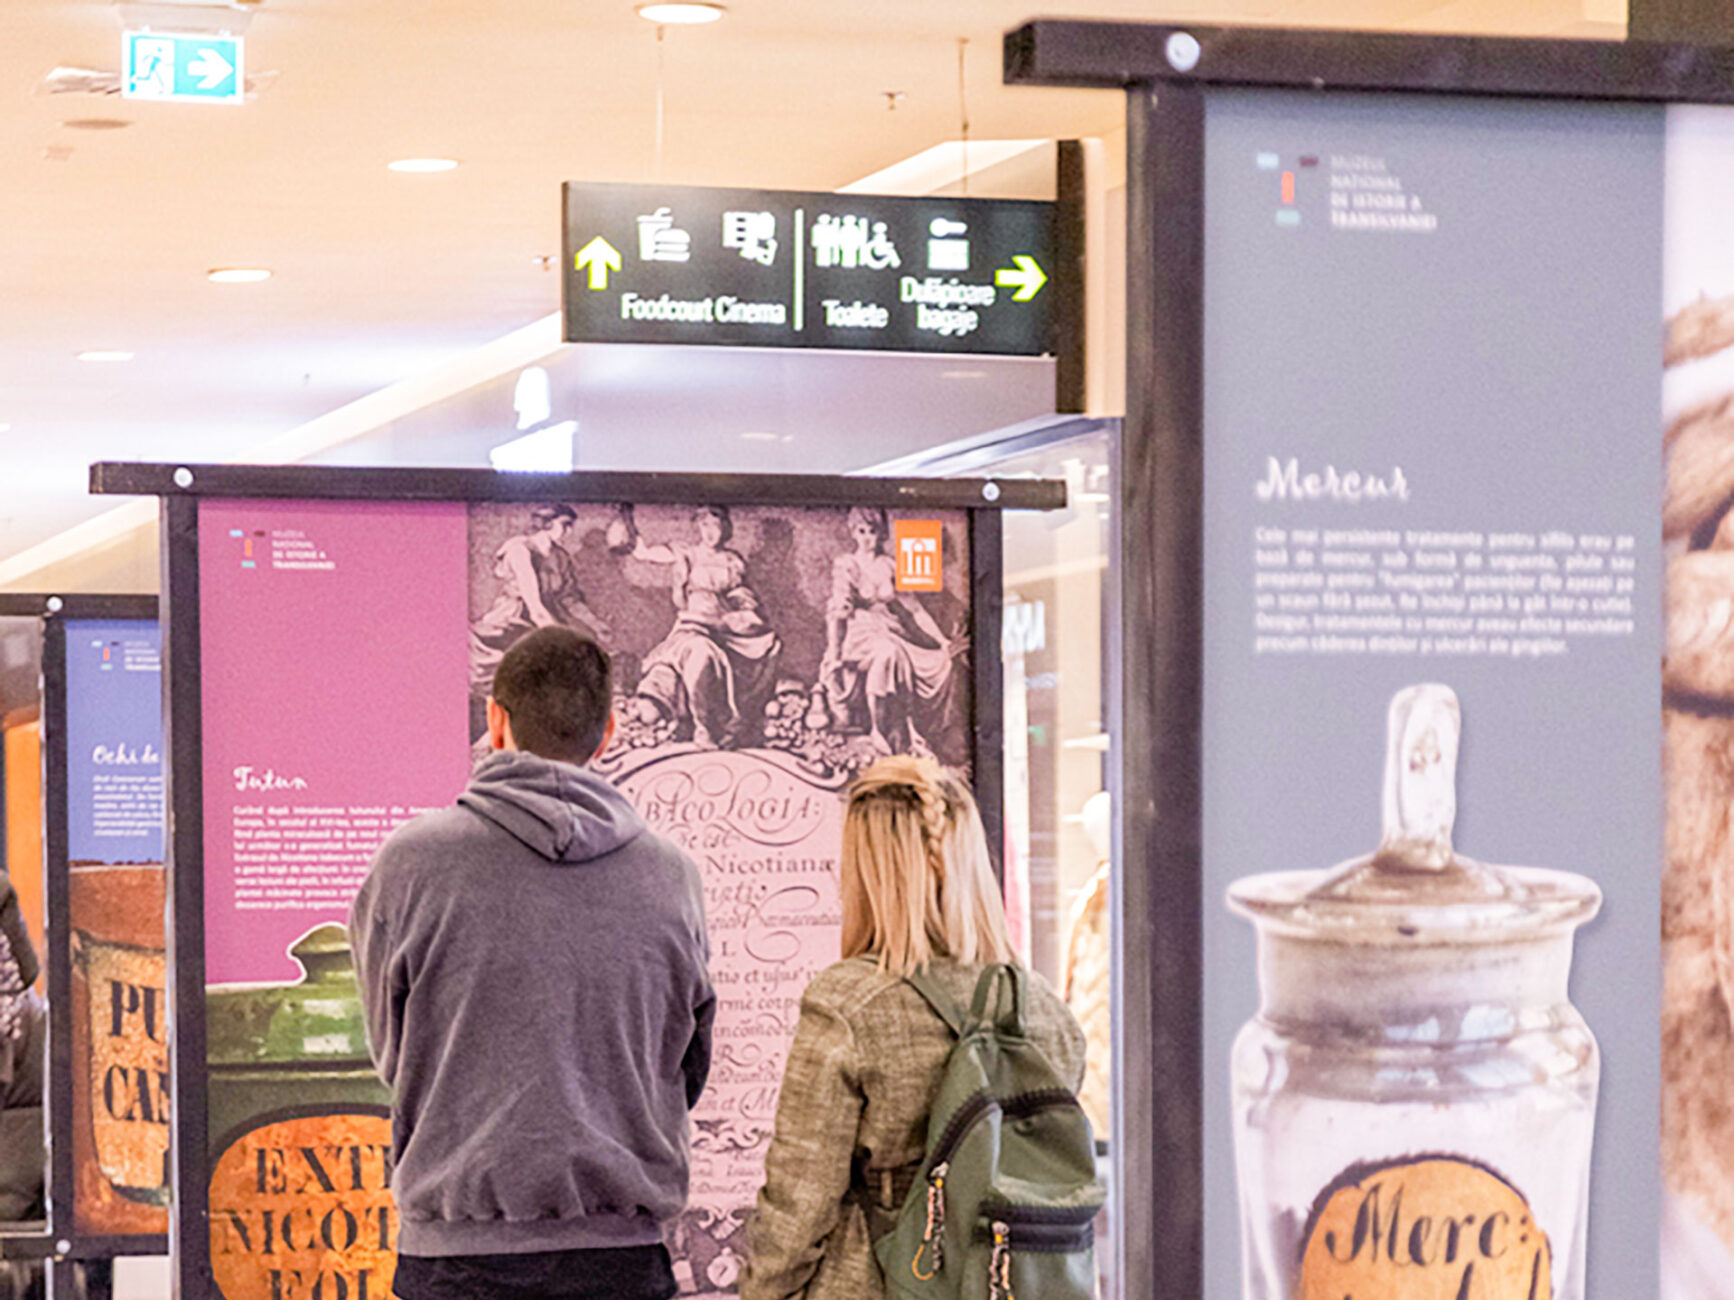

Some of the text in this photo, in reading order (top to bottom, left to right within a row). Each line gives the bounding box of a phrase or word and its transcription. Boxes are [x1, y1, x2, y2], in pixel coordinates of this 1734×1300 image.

[621, 294, 714, 323] Foodcourt
[715, 296, 786, 325] Cinema
[1256, 457, 1409, 500] Mercur
[233, 766, 307, 791] Tutun
